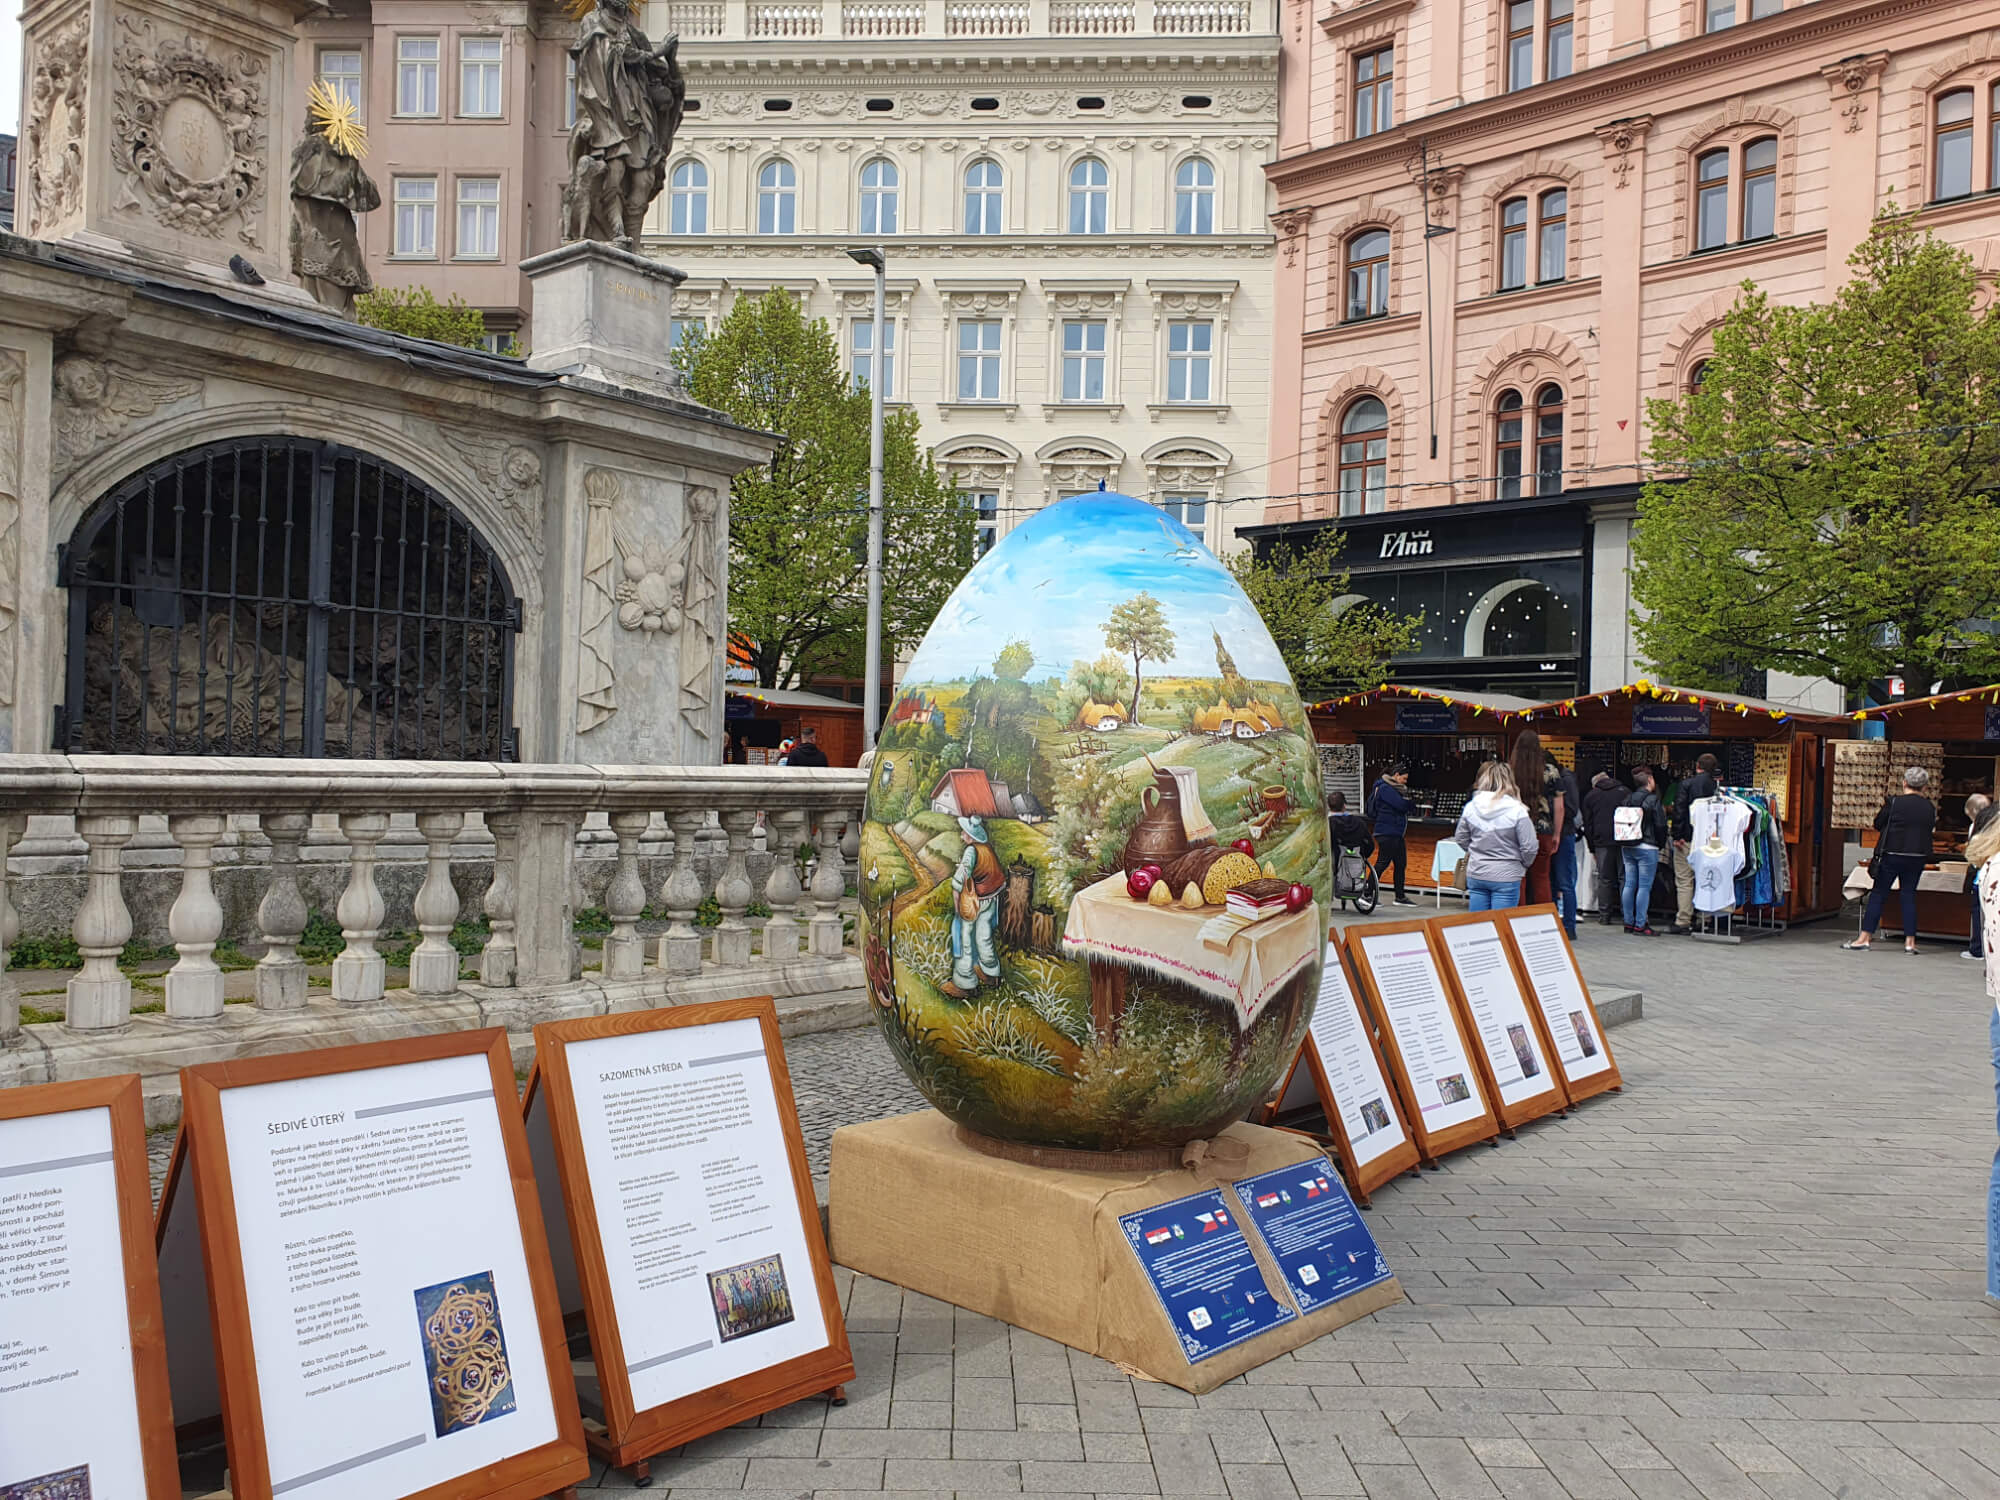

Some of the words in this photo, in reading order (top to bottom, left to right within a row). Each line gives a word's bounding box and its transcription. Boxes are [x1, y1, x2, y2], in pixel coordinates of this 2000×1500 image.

[598, 1065, 651, 1082] SAZOMETNÁ
[651, 1060, 683, 1073] STŘEDA
[266, 1117, 308, 1134] ŠEDIVÉ
[309, 1112, 345, 1127] ÚTERÝ
[16, 1200, 42, 1212] Modré
[16, 1242, 67, 1261] podobenství
[11, 1284, 35, 1296] Tento
